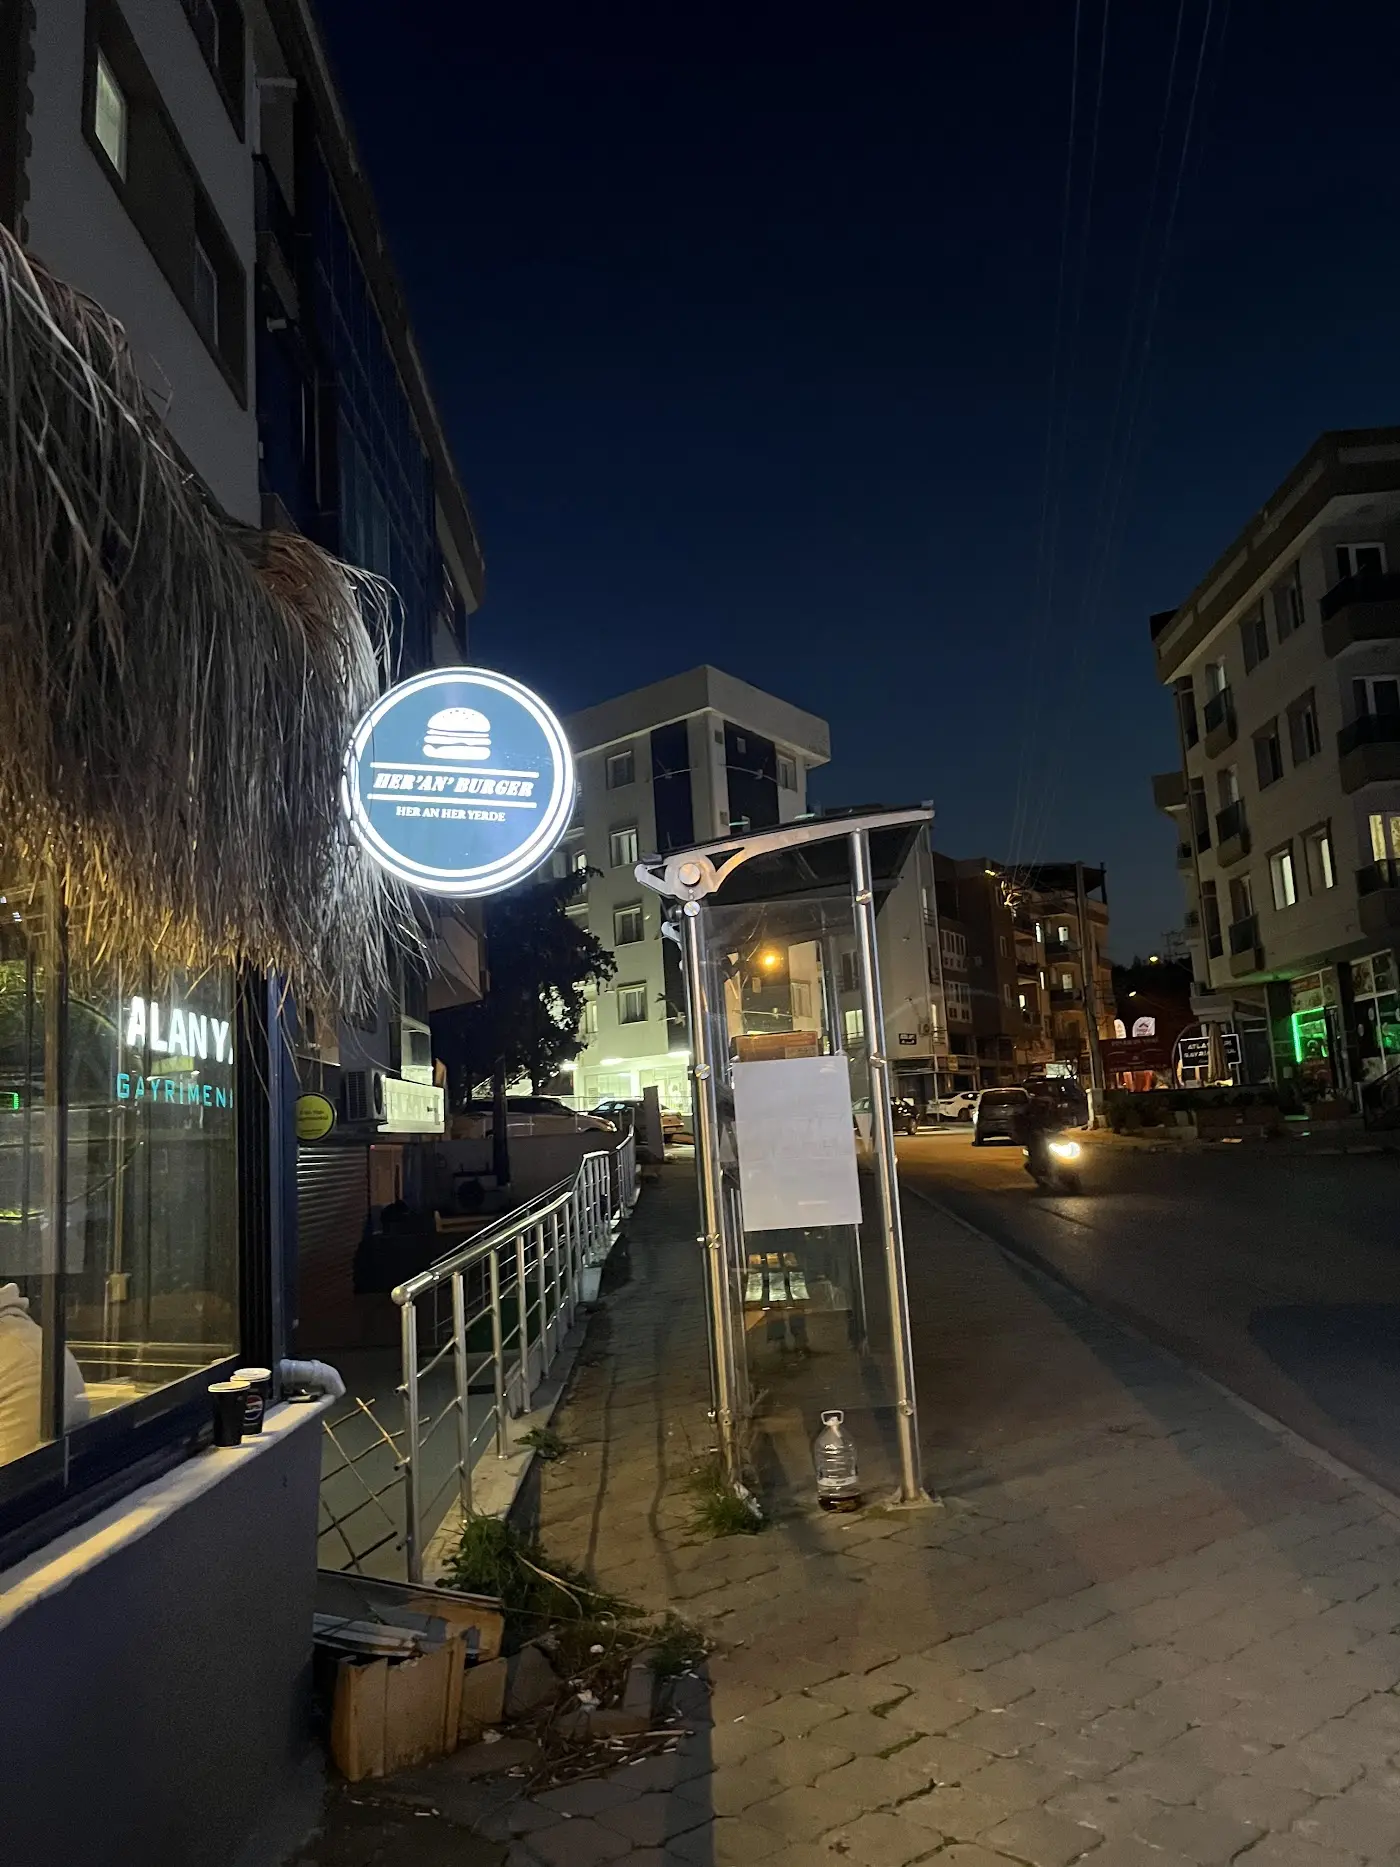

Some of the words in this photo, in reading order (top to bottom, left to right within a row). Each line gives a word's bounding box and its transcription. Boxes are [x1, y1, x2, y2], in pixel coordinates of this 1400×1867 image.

[453, 777, 534, 797] BURGER
[396, 805, 421, 817] HER
[422, 806, 437, 818] AN
[440, 808, 467, 820] HER
[467, 809, 506, 822] YERDE
[127, 996, 233, 1065] ALANY
